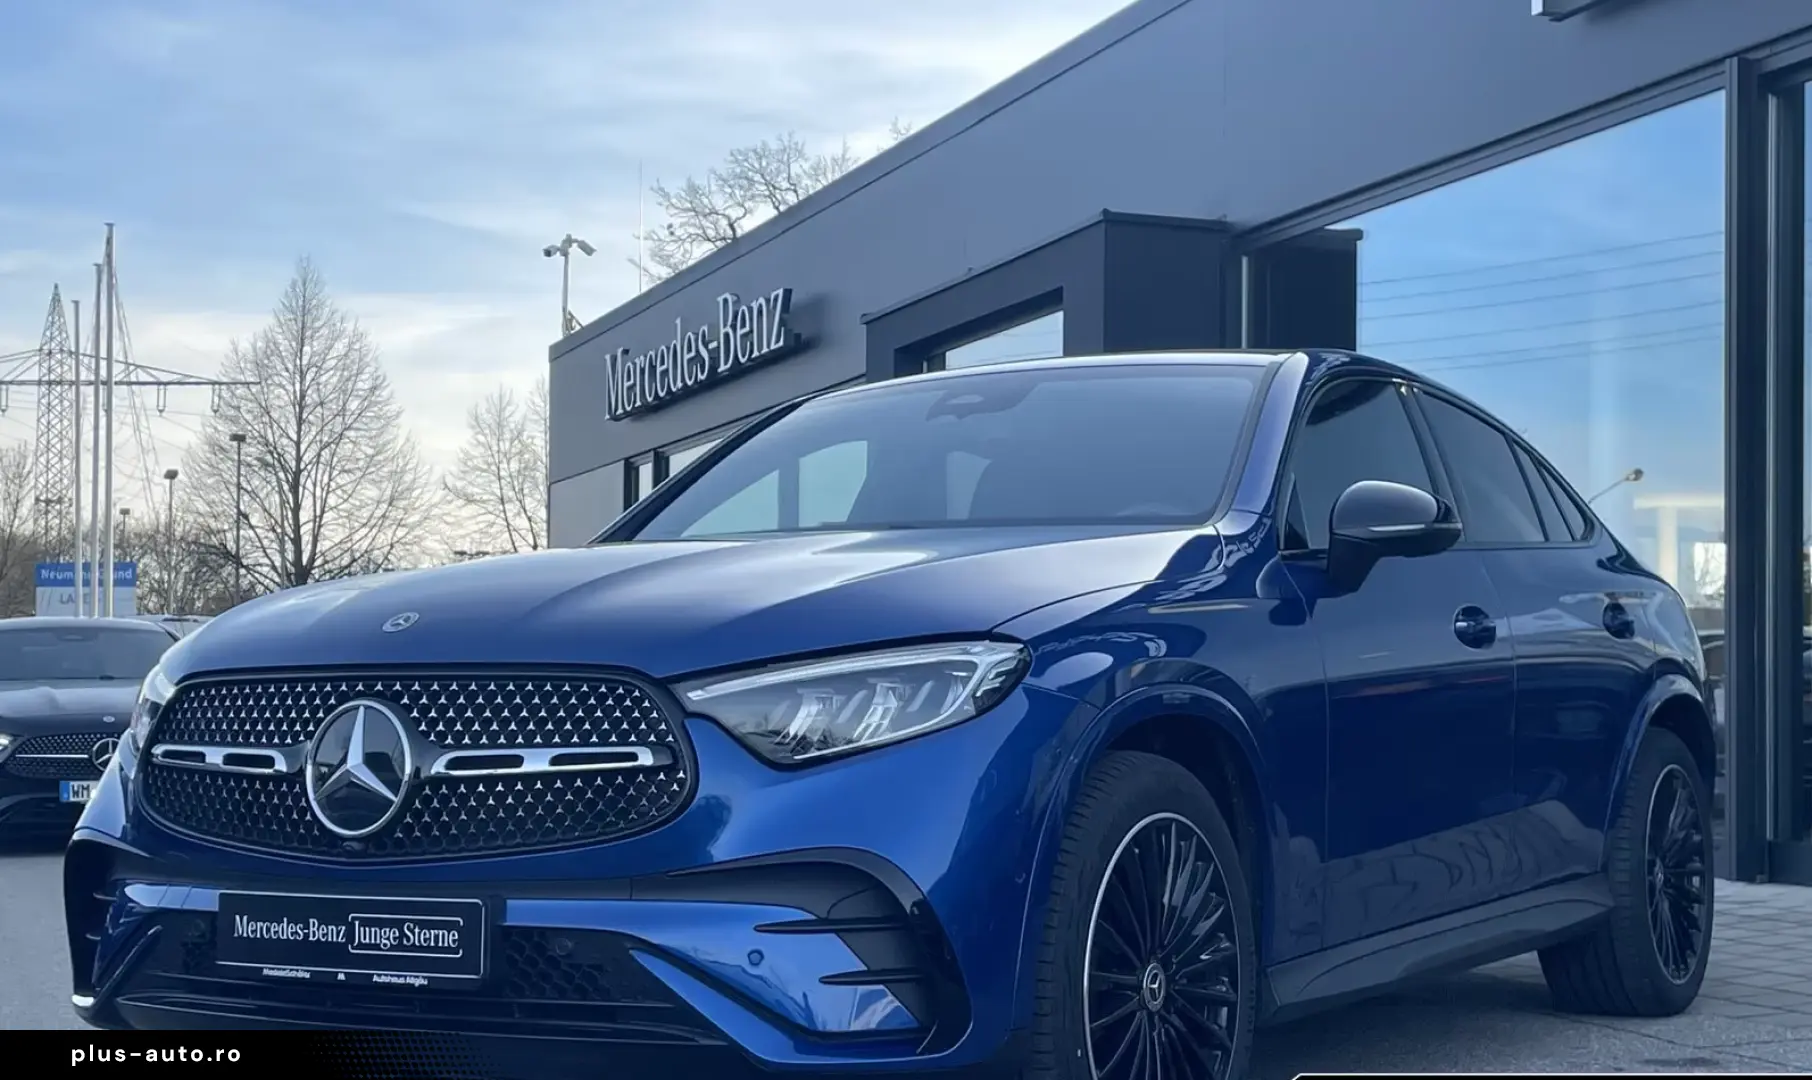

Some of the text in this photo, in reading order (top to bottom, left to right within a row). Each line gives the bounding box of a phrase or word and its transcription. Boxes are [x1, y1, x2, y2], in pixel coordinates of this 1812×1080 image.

[604, 287, 788, 421] Mercedes-Benz
[233, 914, 459, 950] Mercedes-Benz Junge Sterne
